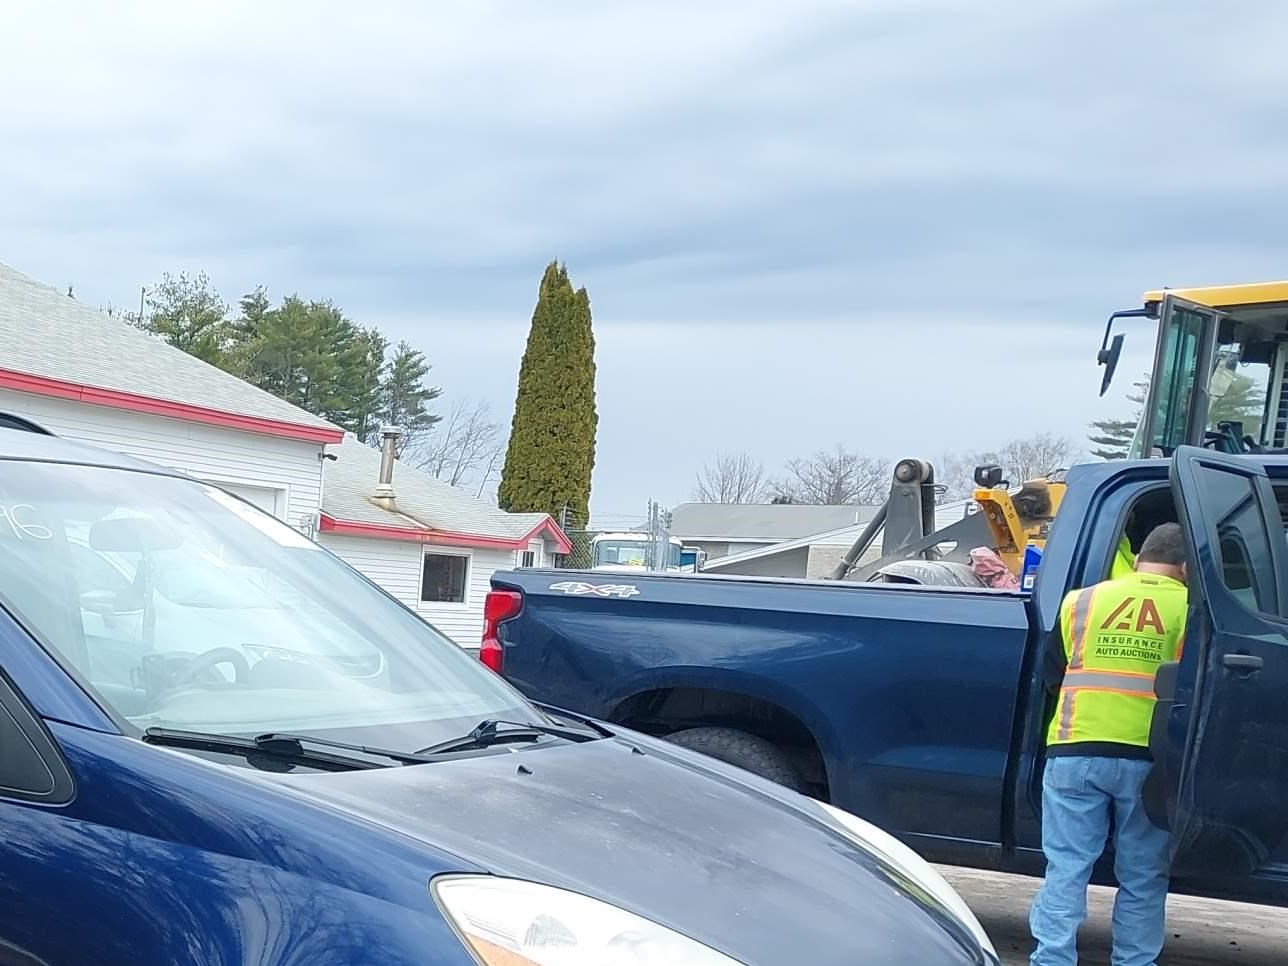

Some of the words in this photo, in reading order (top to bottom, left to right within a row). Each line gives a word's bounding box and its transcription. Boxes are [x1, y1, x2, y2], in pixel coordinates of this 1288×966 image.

[1098, 636, 1164, 650] INSURANCE
[1095, 648, 1119, 656] AUTO
[1119, 648, 1162, 660] AUCTIONS
